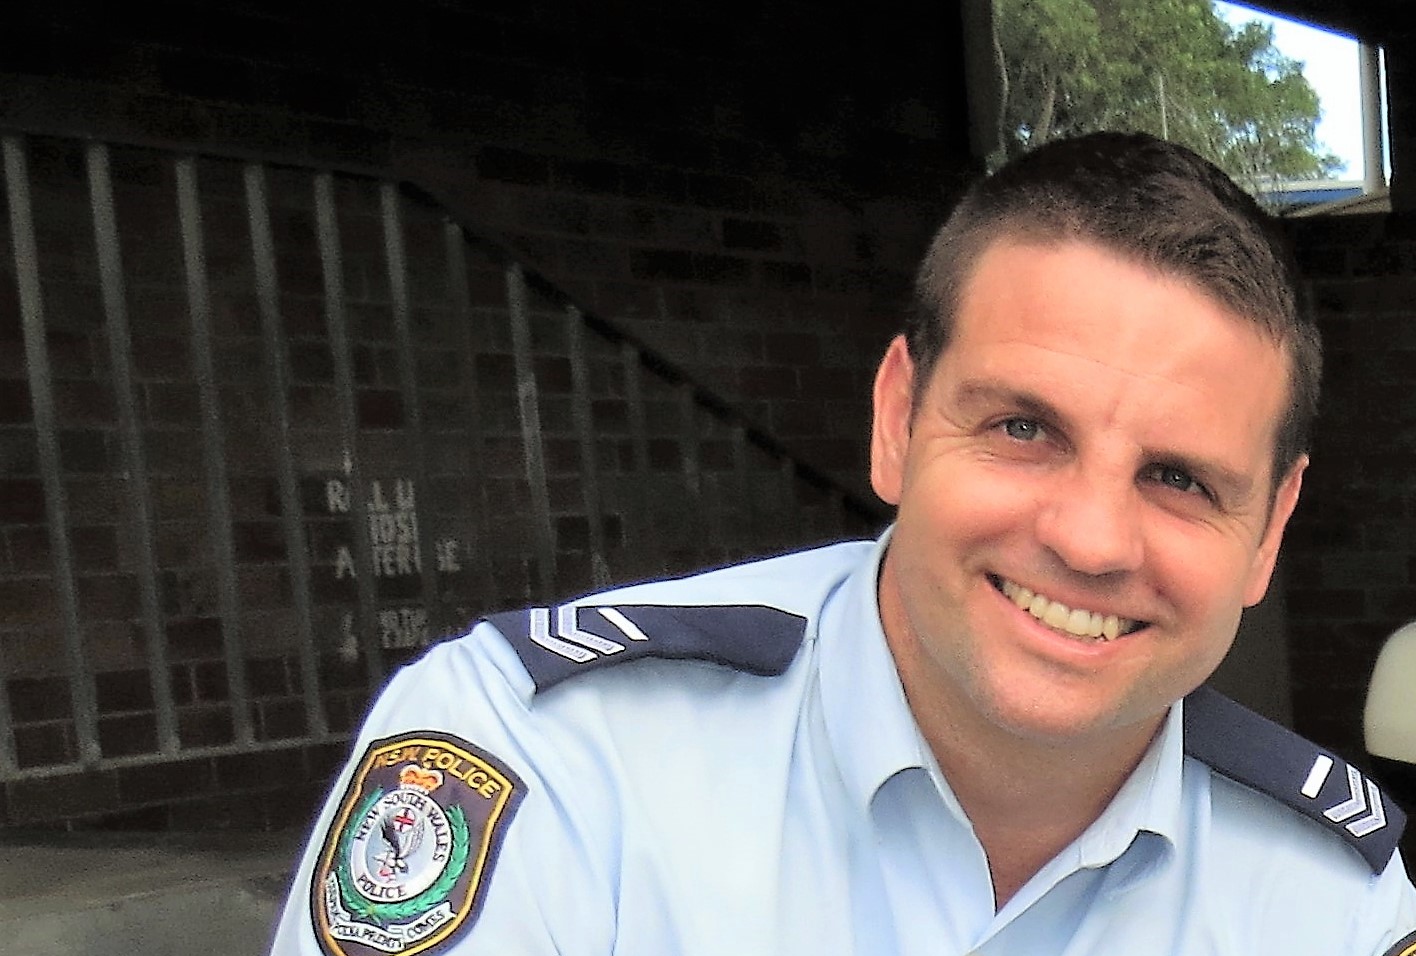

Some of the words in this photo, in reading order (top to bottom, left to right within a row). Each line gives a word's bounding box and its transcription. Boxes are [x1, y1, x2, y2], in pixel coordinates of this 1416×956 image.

[424, 747, 502, 799] POLICE
[353, 810, 380, 842] NEW
[383, 791, 427, 812] SOUTH
[426, 806, 451, 863] WALES
[357, 875, 407, 899] POLICE
